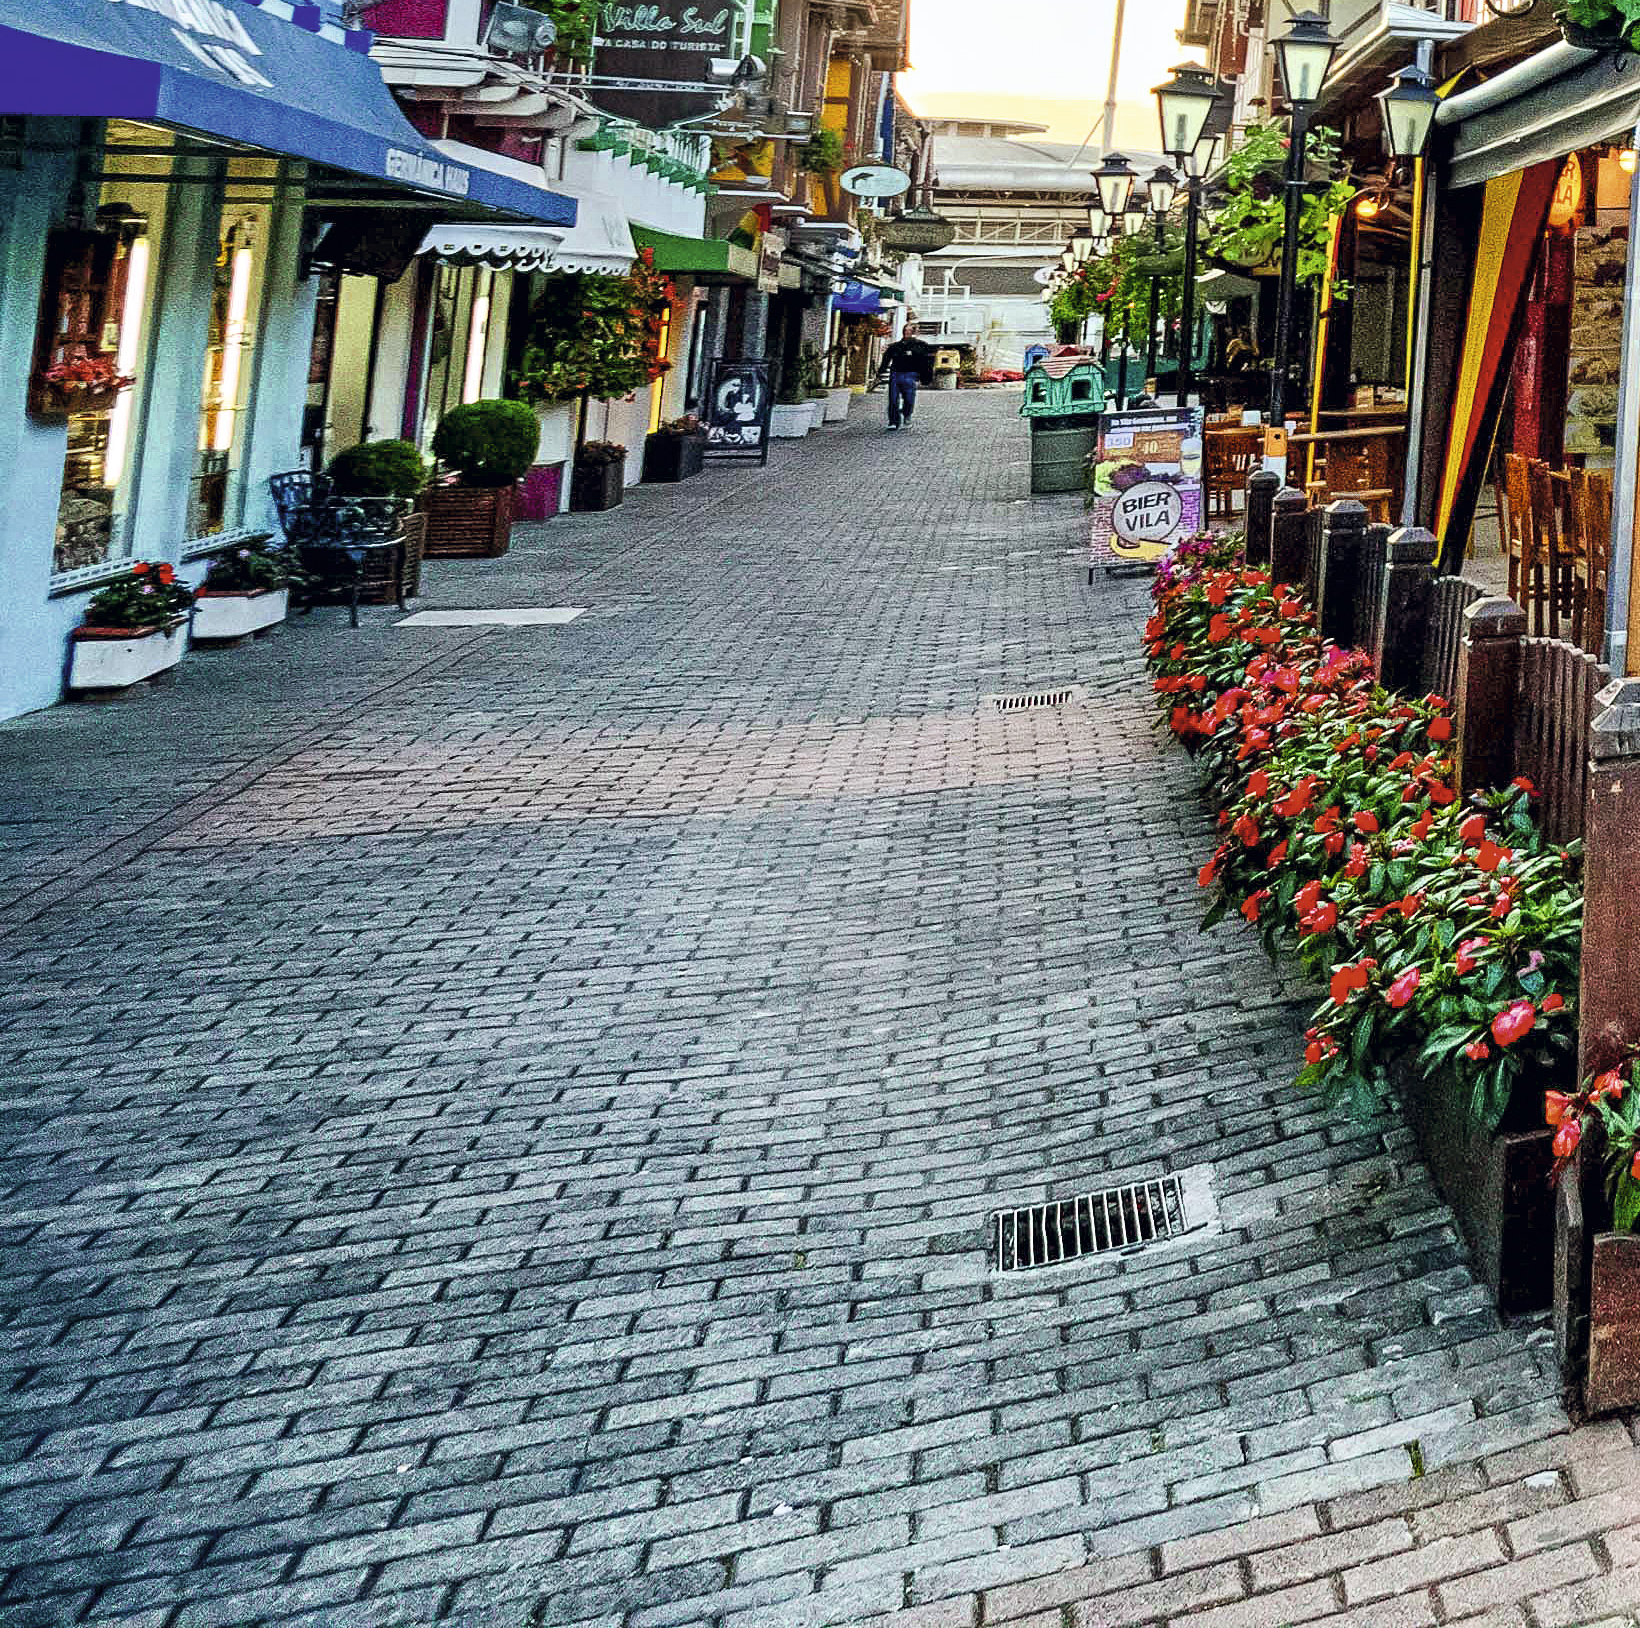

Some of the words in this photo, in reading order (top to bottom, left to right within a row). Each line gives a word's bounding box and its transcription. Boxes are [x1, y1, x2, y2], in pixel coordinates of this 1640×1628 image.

[680, 6, 729, 35] Sul
[651, 40, 667, 50] DO
[1122, 490, 1172, 515] BIER
[1125, 510, 1170, 532] VILA
